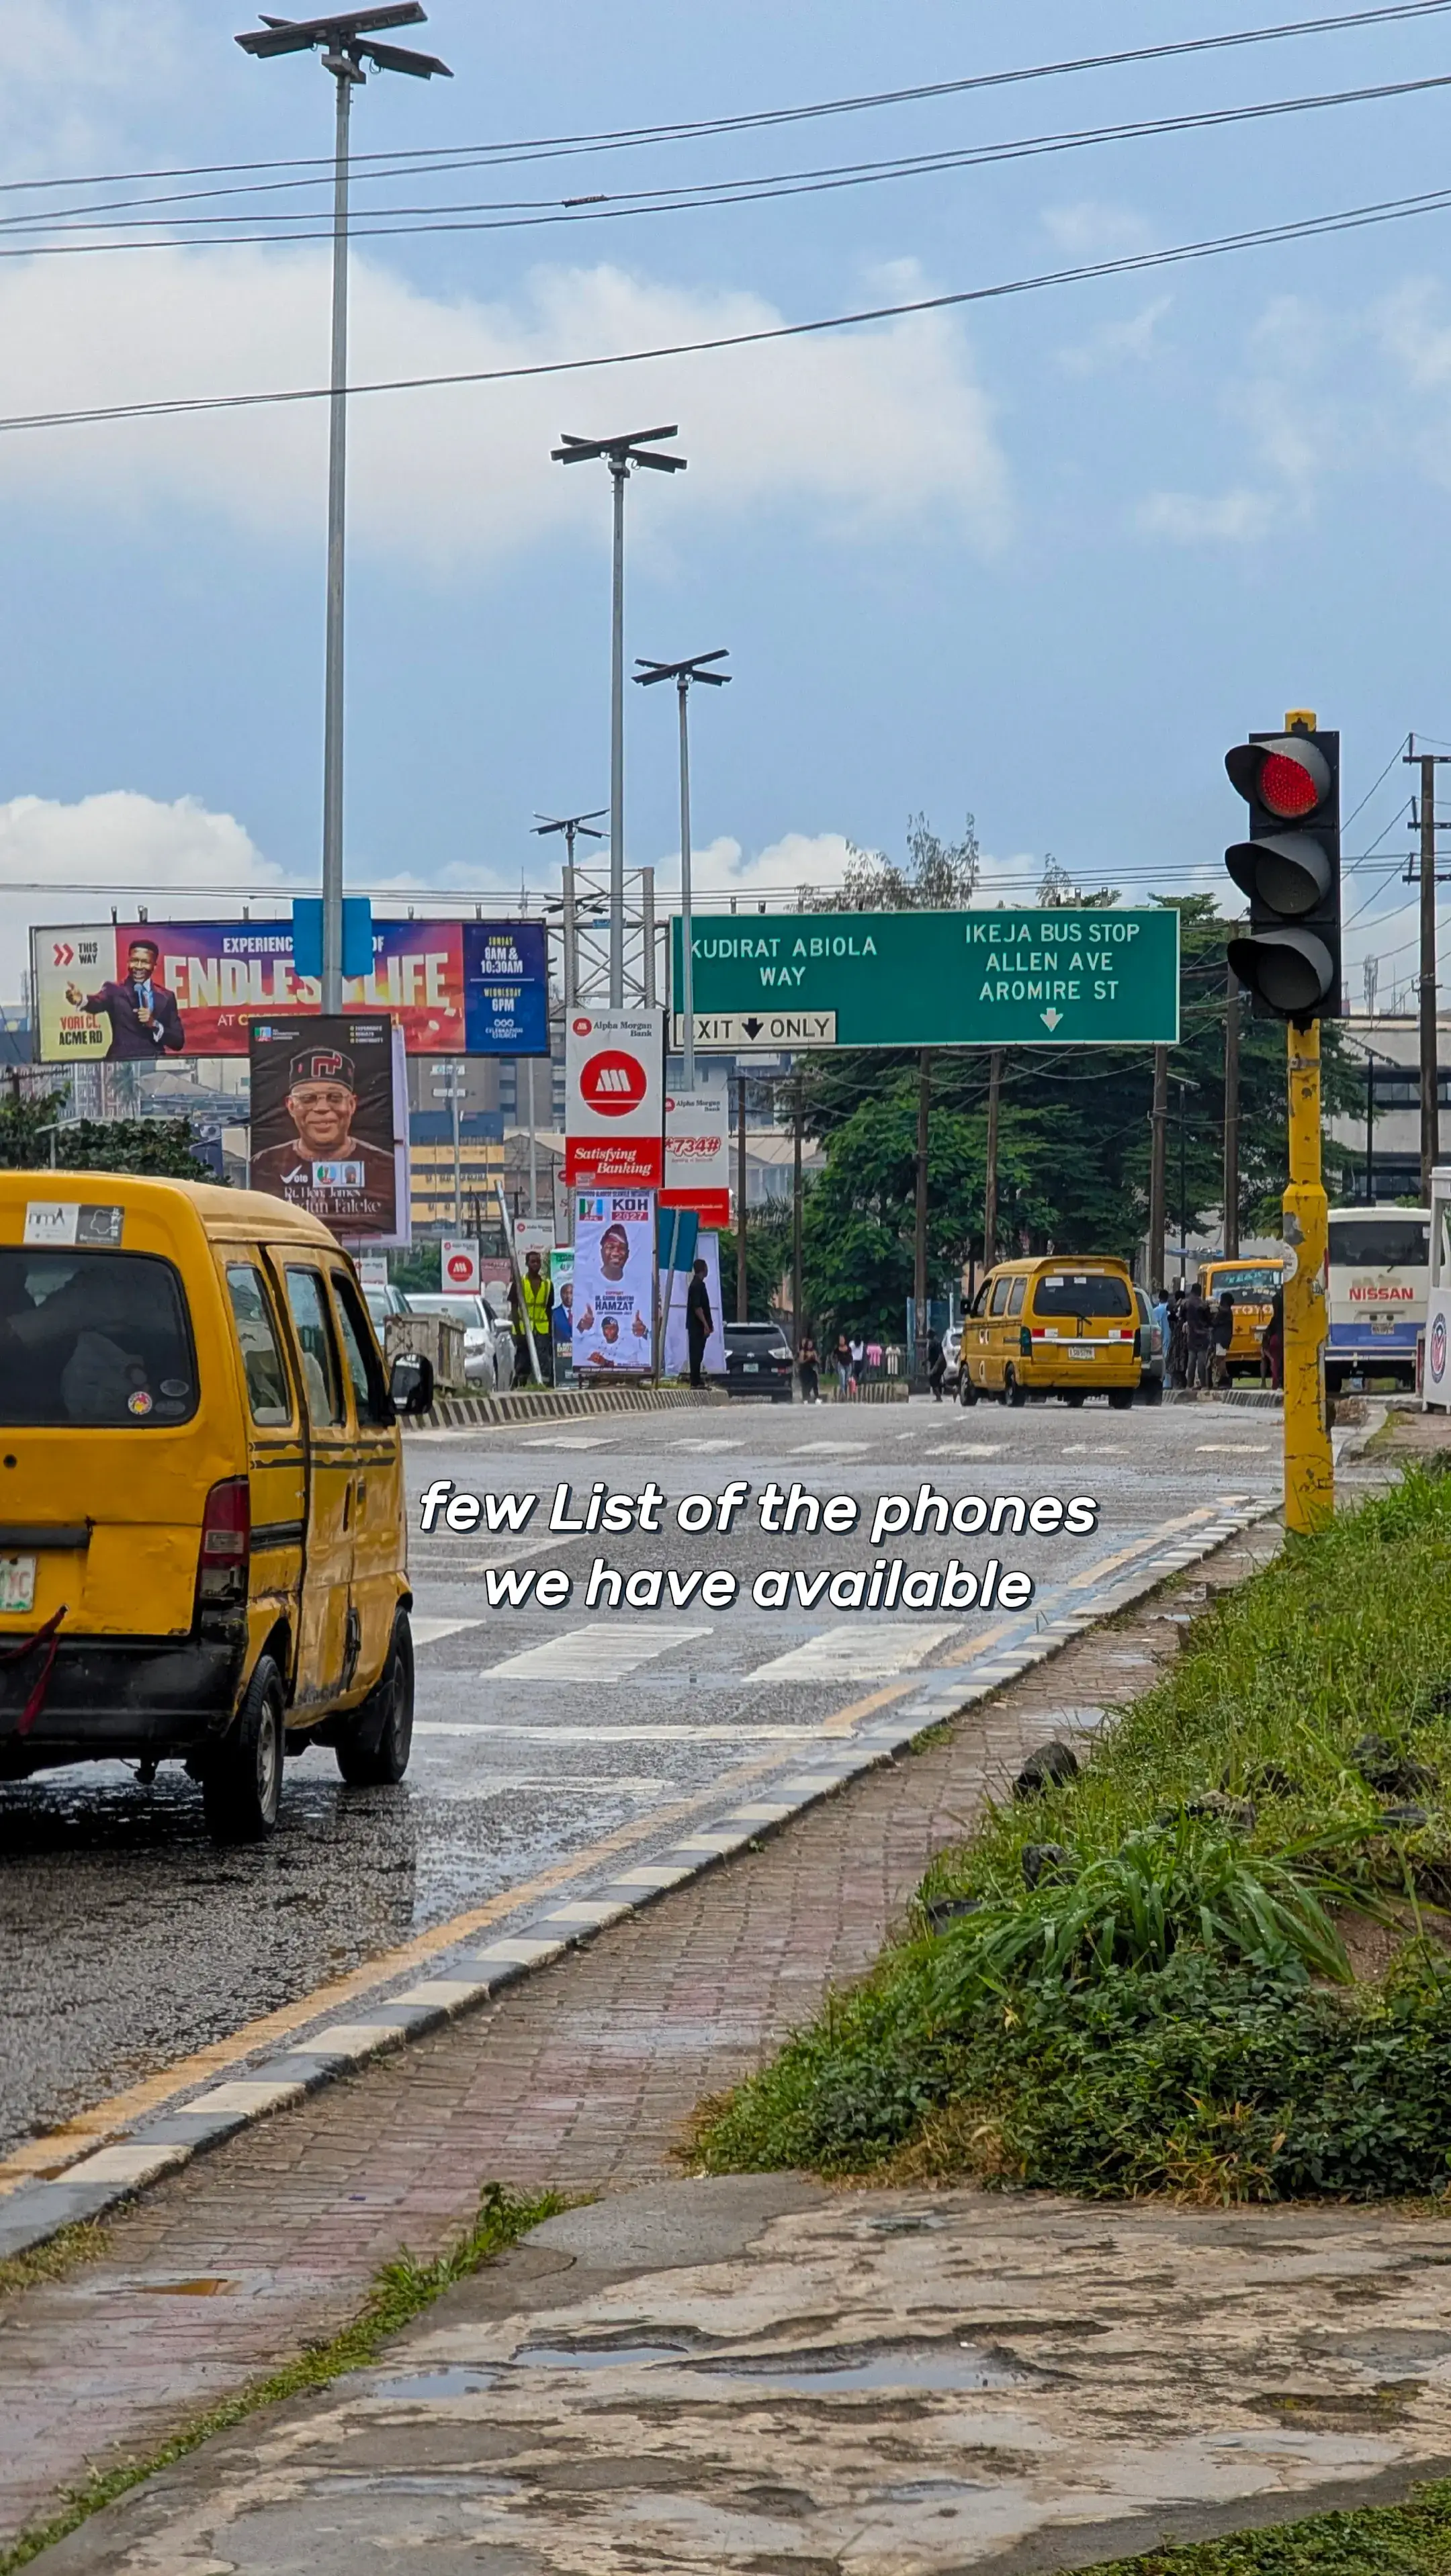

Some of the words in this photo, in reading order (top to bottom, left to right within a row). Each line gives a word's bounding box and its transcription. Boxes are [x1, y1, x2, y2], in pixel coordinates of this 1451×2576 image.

[966, 924, 1032, 944] IKEJA
[1041, 923, 1082, 942] BUS
[1088, 923, 1140, 942] STOP
[78, 942, 98, 954] THIS
[223, 936, 294, 953] EXPERIENC
[691, 939, 781, 958] KUDIRAT
[792, 936, 877, 957] ABIOLA
[79, 954, 97, 964] WAY
[509, 947, 519, 960] &
[481, 960, 523, 974] 10:30AM
[985, 952, 1058, 972] ALLEN
[1068, 952, 1113, 971] AVE
[163, 955, 358, 1009] ENDLES
[364, 952, 449, 1007] LIFE
[760, 966, 806, 986] WAY
[979, 980, 1081, 1002] AROMIRE
[1094, 980, 1118, 1000] ST
[60, 1015, 84, 1031] VORI
[218, 1014, 235, 1026] AT
[593, 1021, 618, 1031] Alpha
[620, 1021, 652, 1030] Morgan
[683, 1019, 733, 1039] XIT
[771, 1017, 830, 1038] ONLY
[59, 1030, 87, 1046] ACME
[89, 1030, 103, 1044] RD
[676, 1099, 695, 1107] Alpha
[696, 1099, 720, 1107] Morgan
[574, 1147, 637, 1162] Satisfying
[597, 1162, 652, 1177] Banking
[328, 1186, 361, 1198] James
[335, 1198, 382, 1213] Faleke
[613, 1199, 648, 1211] KOH
[615, 1212, 644, 1220] 2027
[1349, 1287, 1413, 1301] NISSAN
[595, 1301, 634, 1311] HAMZAT
[1230, 1305, 1274, 1315] TOYO
